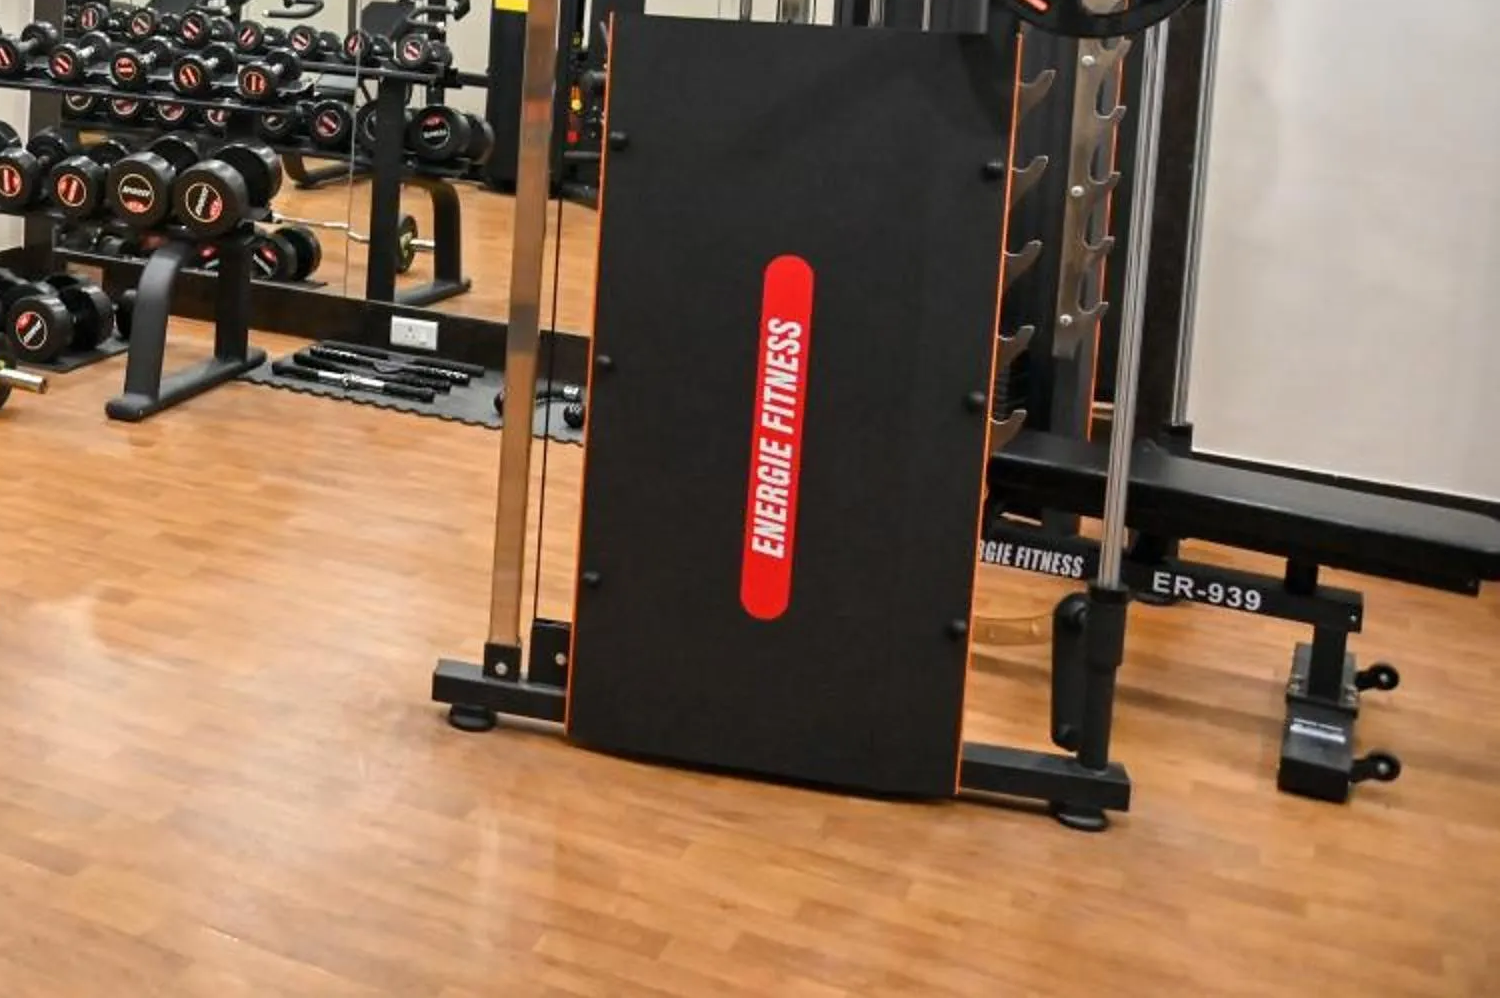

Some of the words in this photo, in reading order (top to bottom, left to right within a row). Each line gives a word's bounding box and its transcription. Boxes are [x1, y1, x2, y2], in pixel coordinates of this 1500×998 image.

[761, 317, 802, 434] FITNESS
[751, 437, 793, 559] ENERGIE
[1014, 545, 1084, 579] FITNESS
[1152, 571, 1262, 612] ER-939
